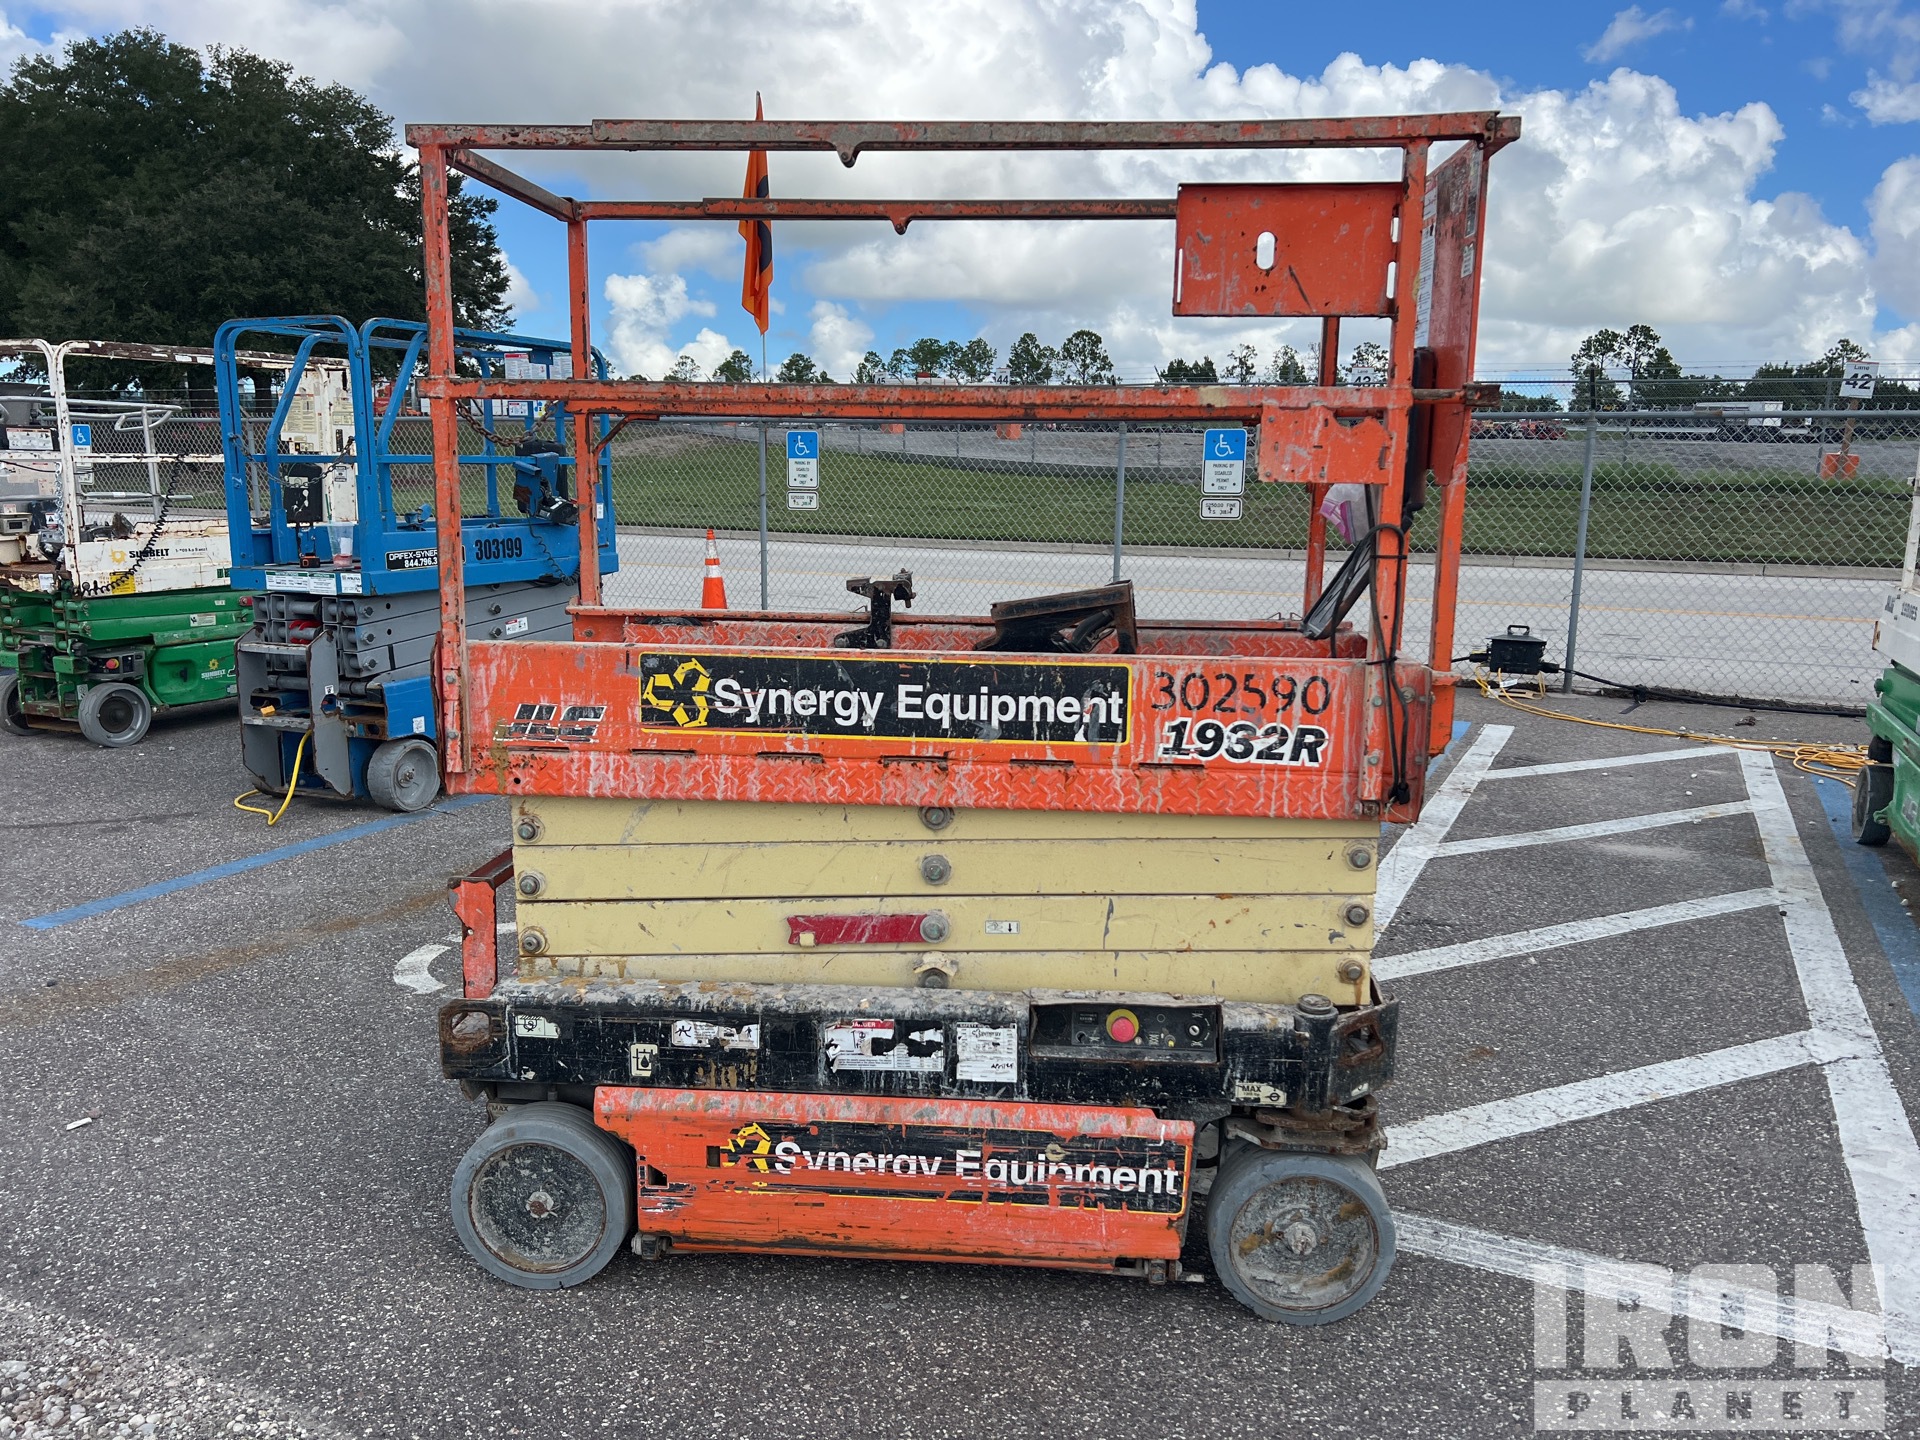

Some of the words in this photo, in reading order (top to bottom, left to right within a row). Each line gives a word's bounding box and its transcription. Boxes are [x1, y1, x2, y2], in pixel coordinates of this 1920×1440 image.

[1845, 373, 1873, 389] 42
[474, 537, 523, 561] 303199
[714, 678, 885, 728] Synergy
[898, 684, 1123, 729] Equipment
[1151, 671, 1332, 715] 302590
[1157, 717, 1330, 767] 1932R
